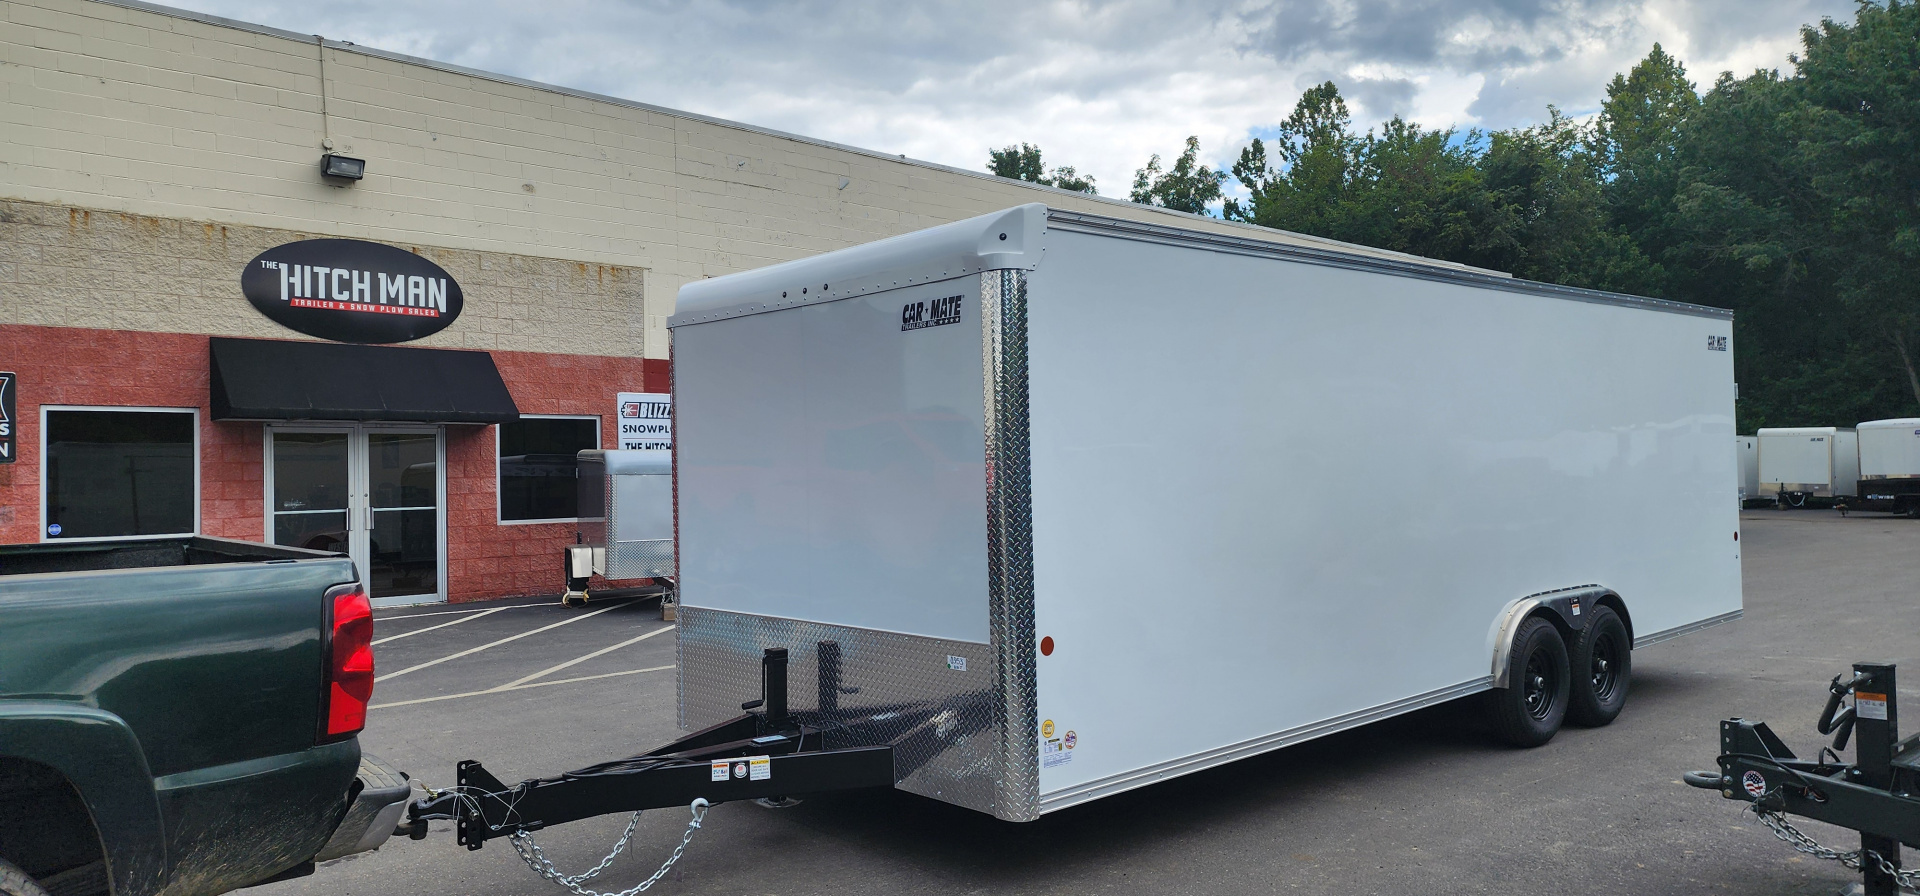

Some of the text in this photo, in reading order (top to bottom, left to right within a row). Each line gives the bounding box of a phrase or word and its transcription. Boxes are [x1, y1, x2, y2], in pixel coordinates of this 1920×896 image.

[261, 260, 278, 270] THE
[279, 263, 447, 313] HITCH MAN
[294, 299, 334, 309] TRAILER
[350, 303, 375, 311] SNOW
[408, 308, 435, 316] SALES
[902, 295, 962, 324] CAR MATE
[622, 424, 672, 433] SNOWPL
